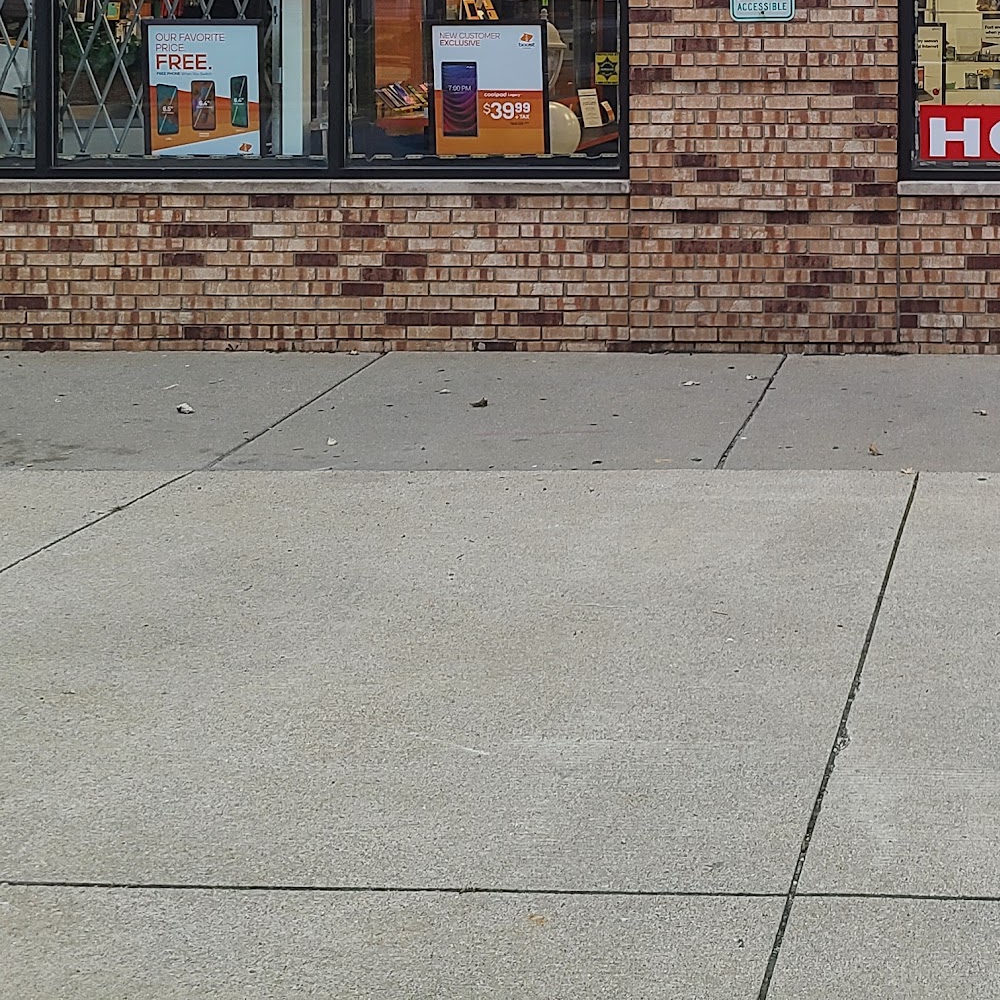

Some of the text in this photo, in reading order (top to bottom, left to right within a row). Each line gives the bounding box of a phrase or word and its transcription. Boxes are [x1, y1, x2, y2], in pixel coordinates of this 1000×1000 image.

[737, 2, 787, 11] ACCESSIBLE
[155, 33, 225, 42] OUR FAVORITE
[156, 54, 212, 70] FREE.
